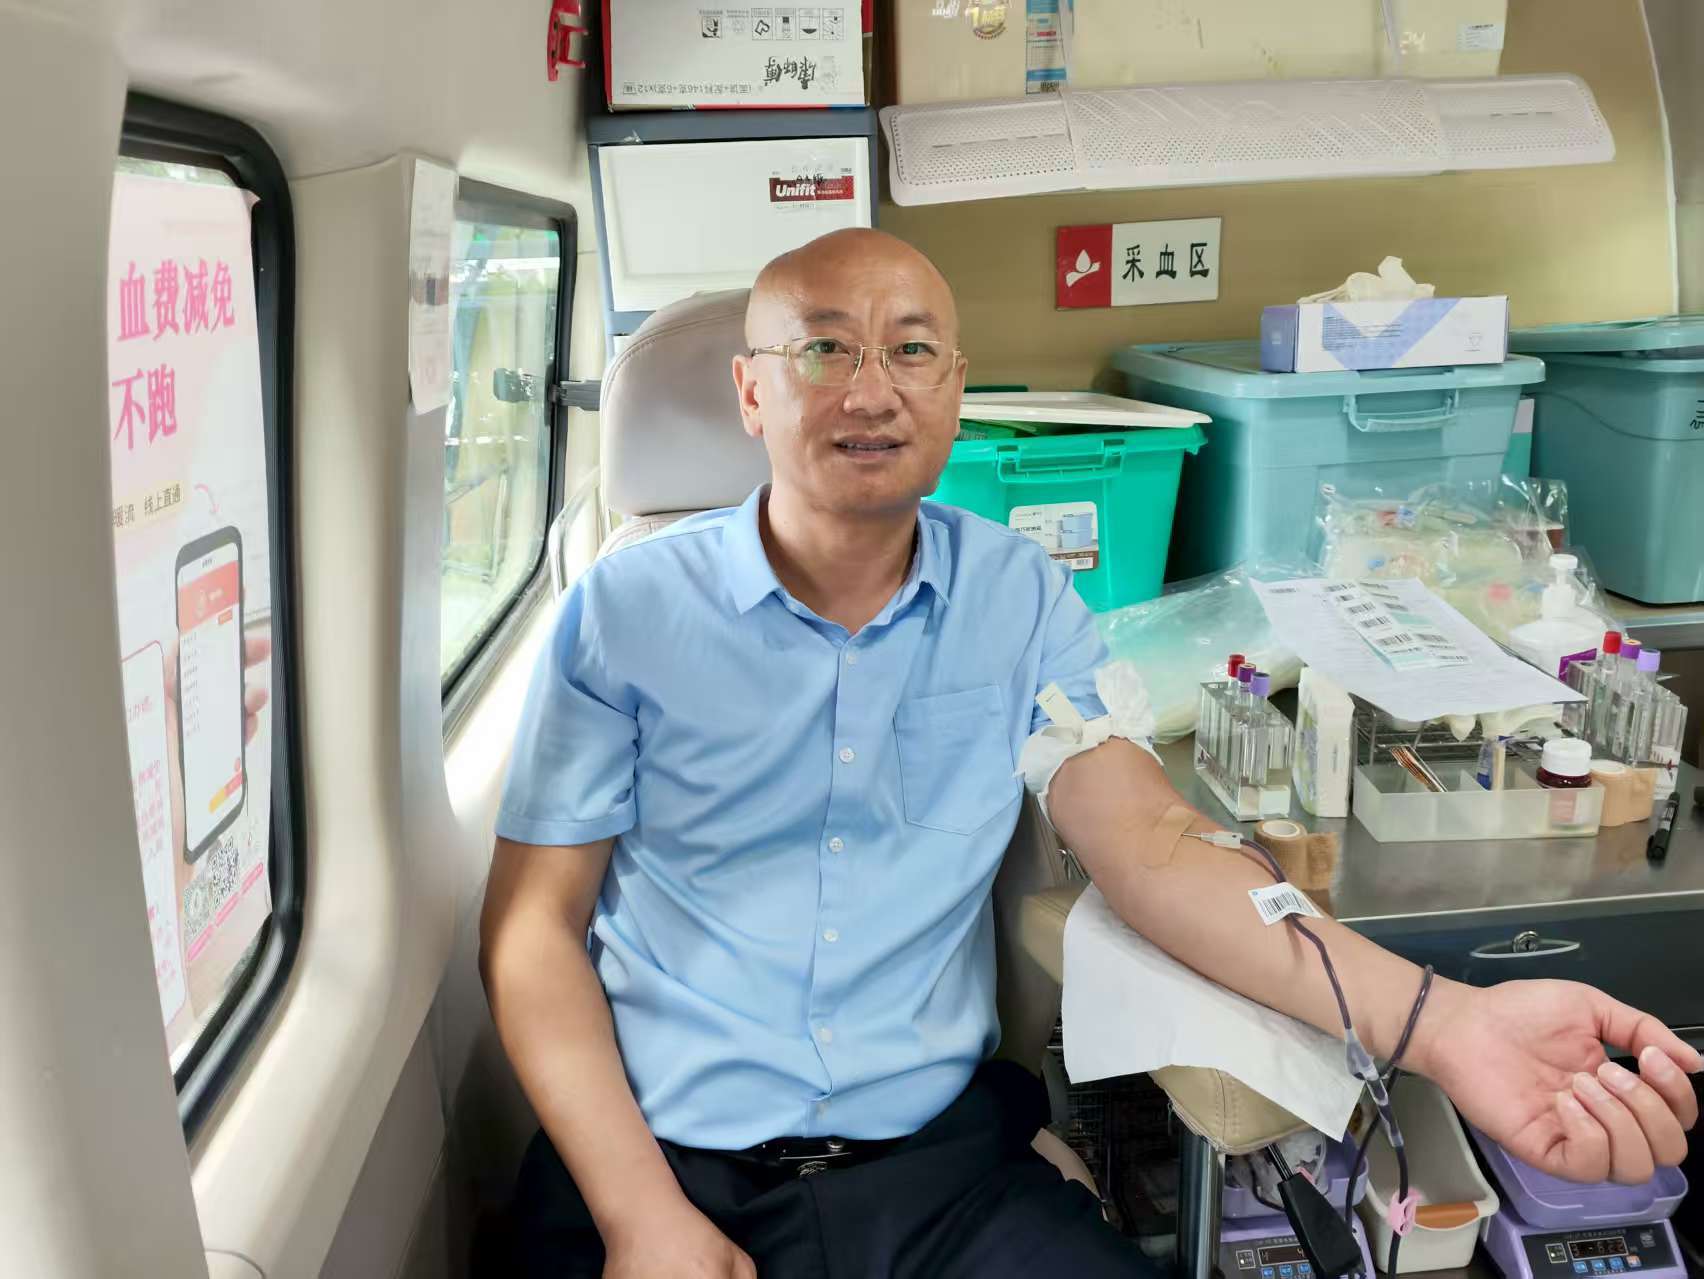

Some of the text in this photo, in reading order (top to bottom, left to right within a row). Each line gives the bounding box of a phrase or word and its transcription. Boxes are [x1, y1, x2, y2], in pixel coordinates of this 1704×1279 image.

[776, 183, 816, 197] Unifit
[1122, 243, 1210, 282] 采血区
[117, 257, 236, 342] 血费减免
[112, 363, 177, 449] 不跑
